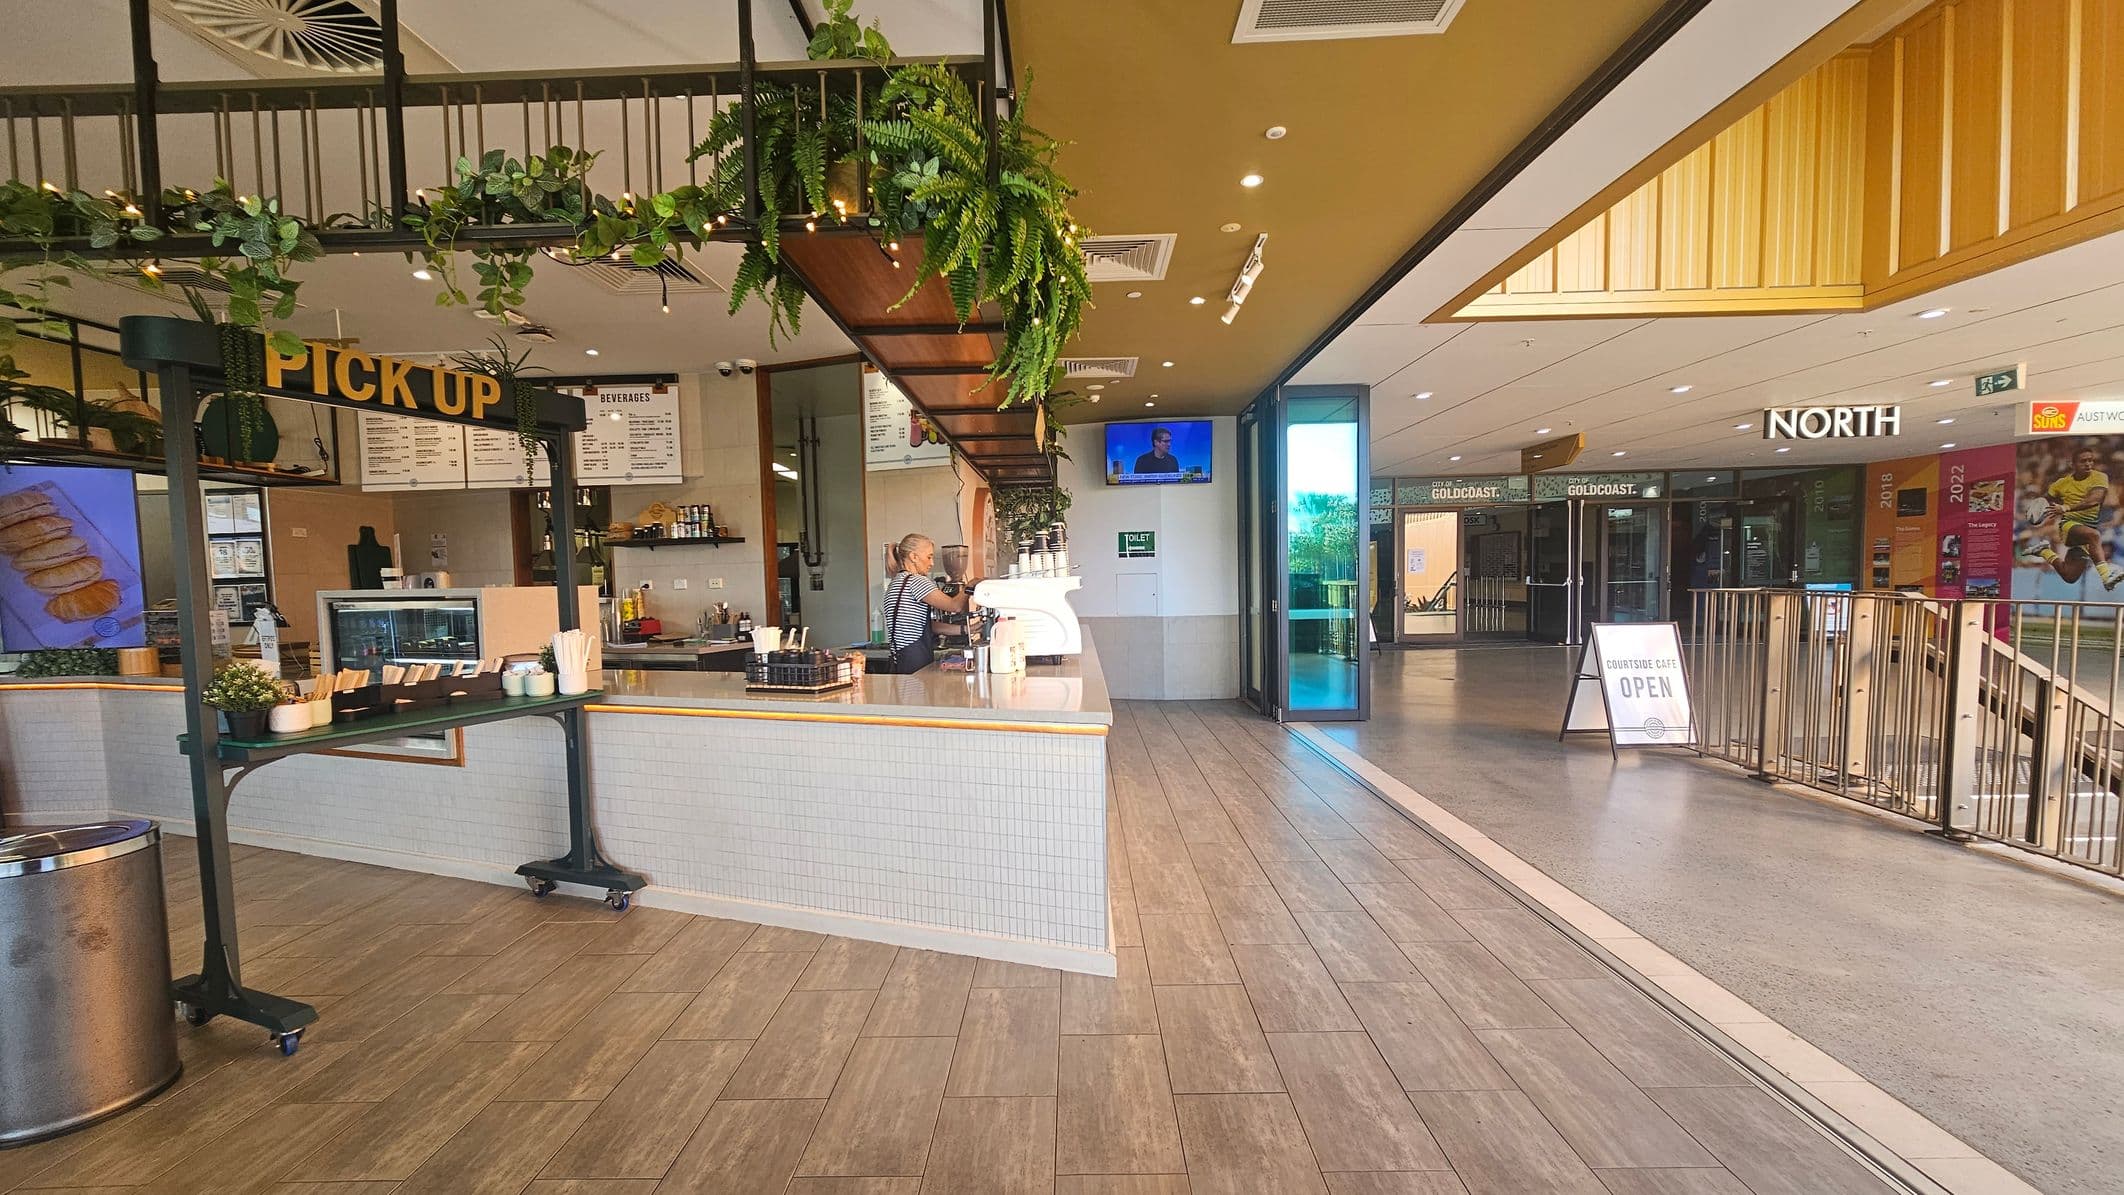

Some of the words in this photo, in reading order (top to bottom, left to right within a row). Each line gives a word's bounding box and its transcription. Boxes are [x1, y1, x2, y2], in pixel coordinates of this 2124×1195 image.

[266, 332, 418, 409] PICK
[433, 366, 501, 419] UP
[600, 393, 650, 403] BEVERAGES
[1764, 406, 1900, 439] NORTH
[2033, 413, 2066, 429] SUNS
[1880, 473, 1893, 509] 2018
[1950, 464, 1965, 503] 2022
[1124, 533, 1150, 542] TOILET
[1606, 659, 1654, 669] COURTSIDE
[1656, 659, 1678, 669] CAFE
[1620, 676, 1673, 698] OPEN
